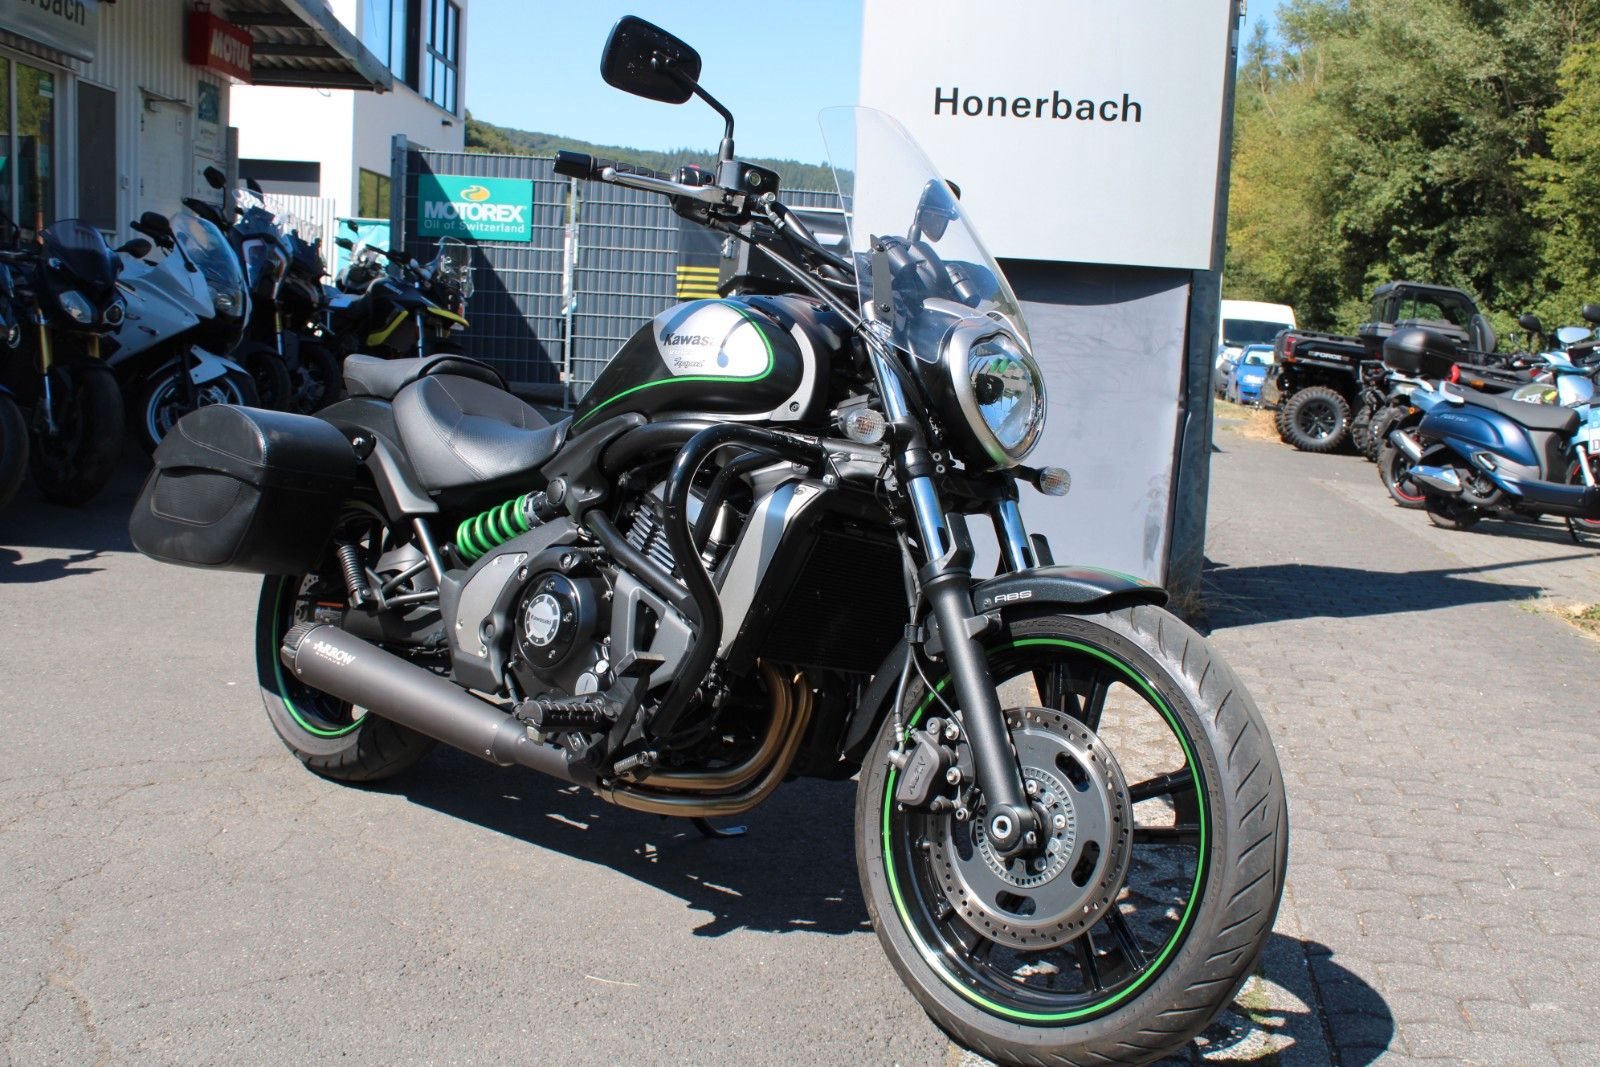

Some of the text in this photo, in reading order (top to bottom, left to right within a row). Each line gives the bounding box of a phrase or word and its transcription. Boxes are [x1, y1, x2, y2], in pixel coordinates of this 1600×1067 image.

[210, 28, 251, 71] MOTUL
[934, 86, 1142, 123] Honerbach
[424, 201, 524, 223] MOTOREX
[423, 219, 525, 233] Oil of Switzerland
[663, 333, 713, 346] Kawas
[994, 590, 1033, 603] ABS
[315, 640, 357, 665] ARROW
